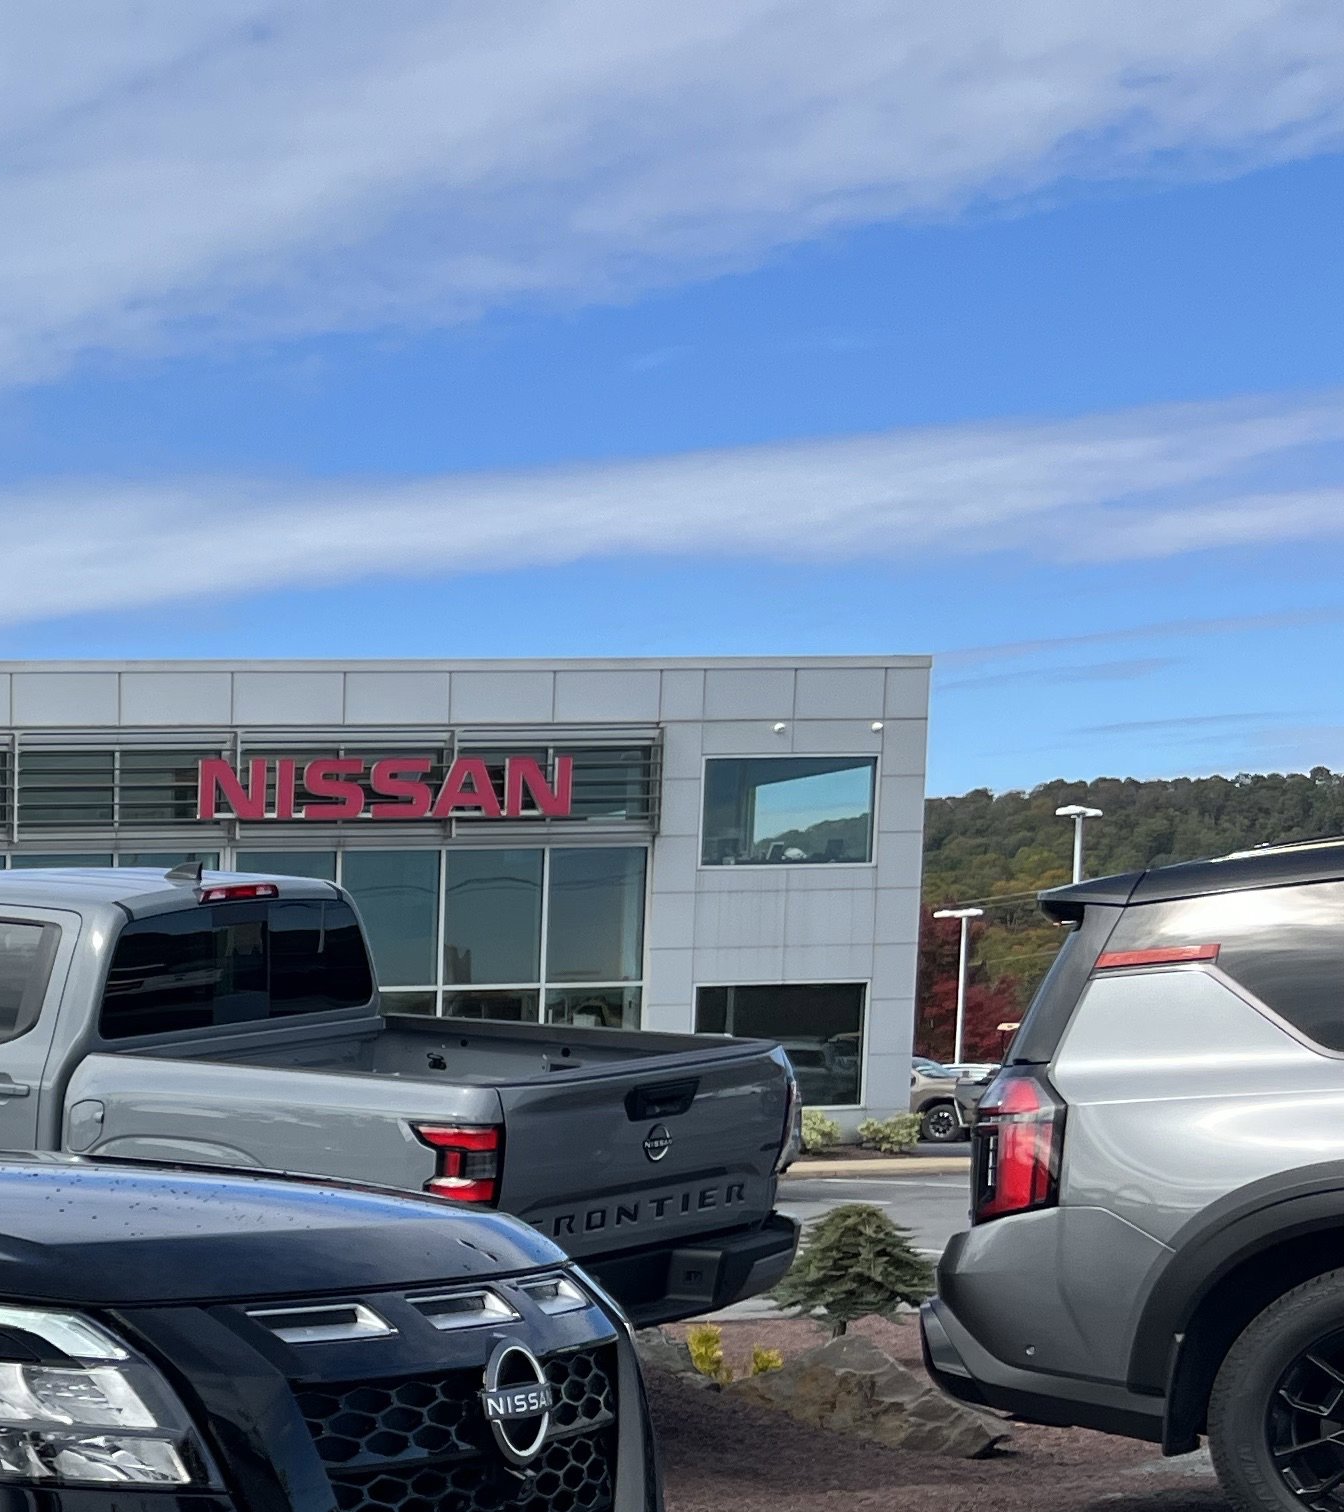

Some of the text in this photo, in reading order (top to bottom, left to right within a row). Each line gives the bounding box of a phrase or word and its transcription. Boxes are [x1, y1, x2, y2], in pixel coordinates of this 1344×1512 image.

[197, 756, 573, 820] NISSAN
[644, 1139, 673, 1148] NISSAN
[528, 1182, 746, 1237] RONTIER
[486, 1388, 552, 1416] NISSAN
